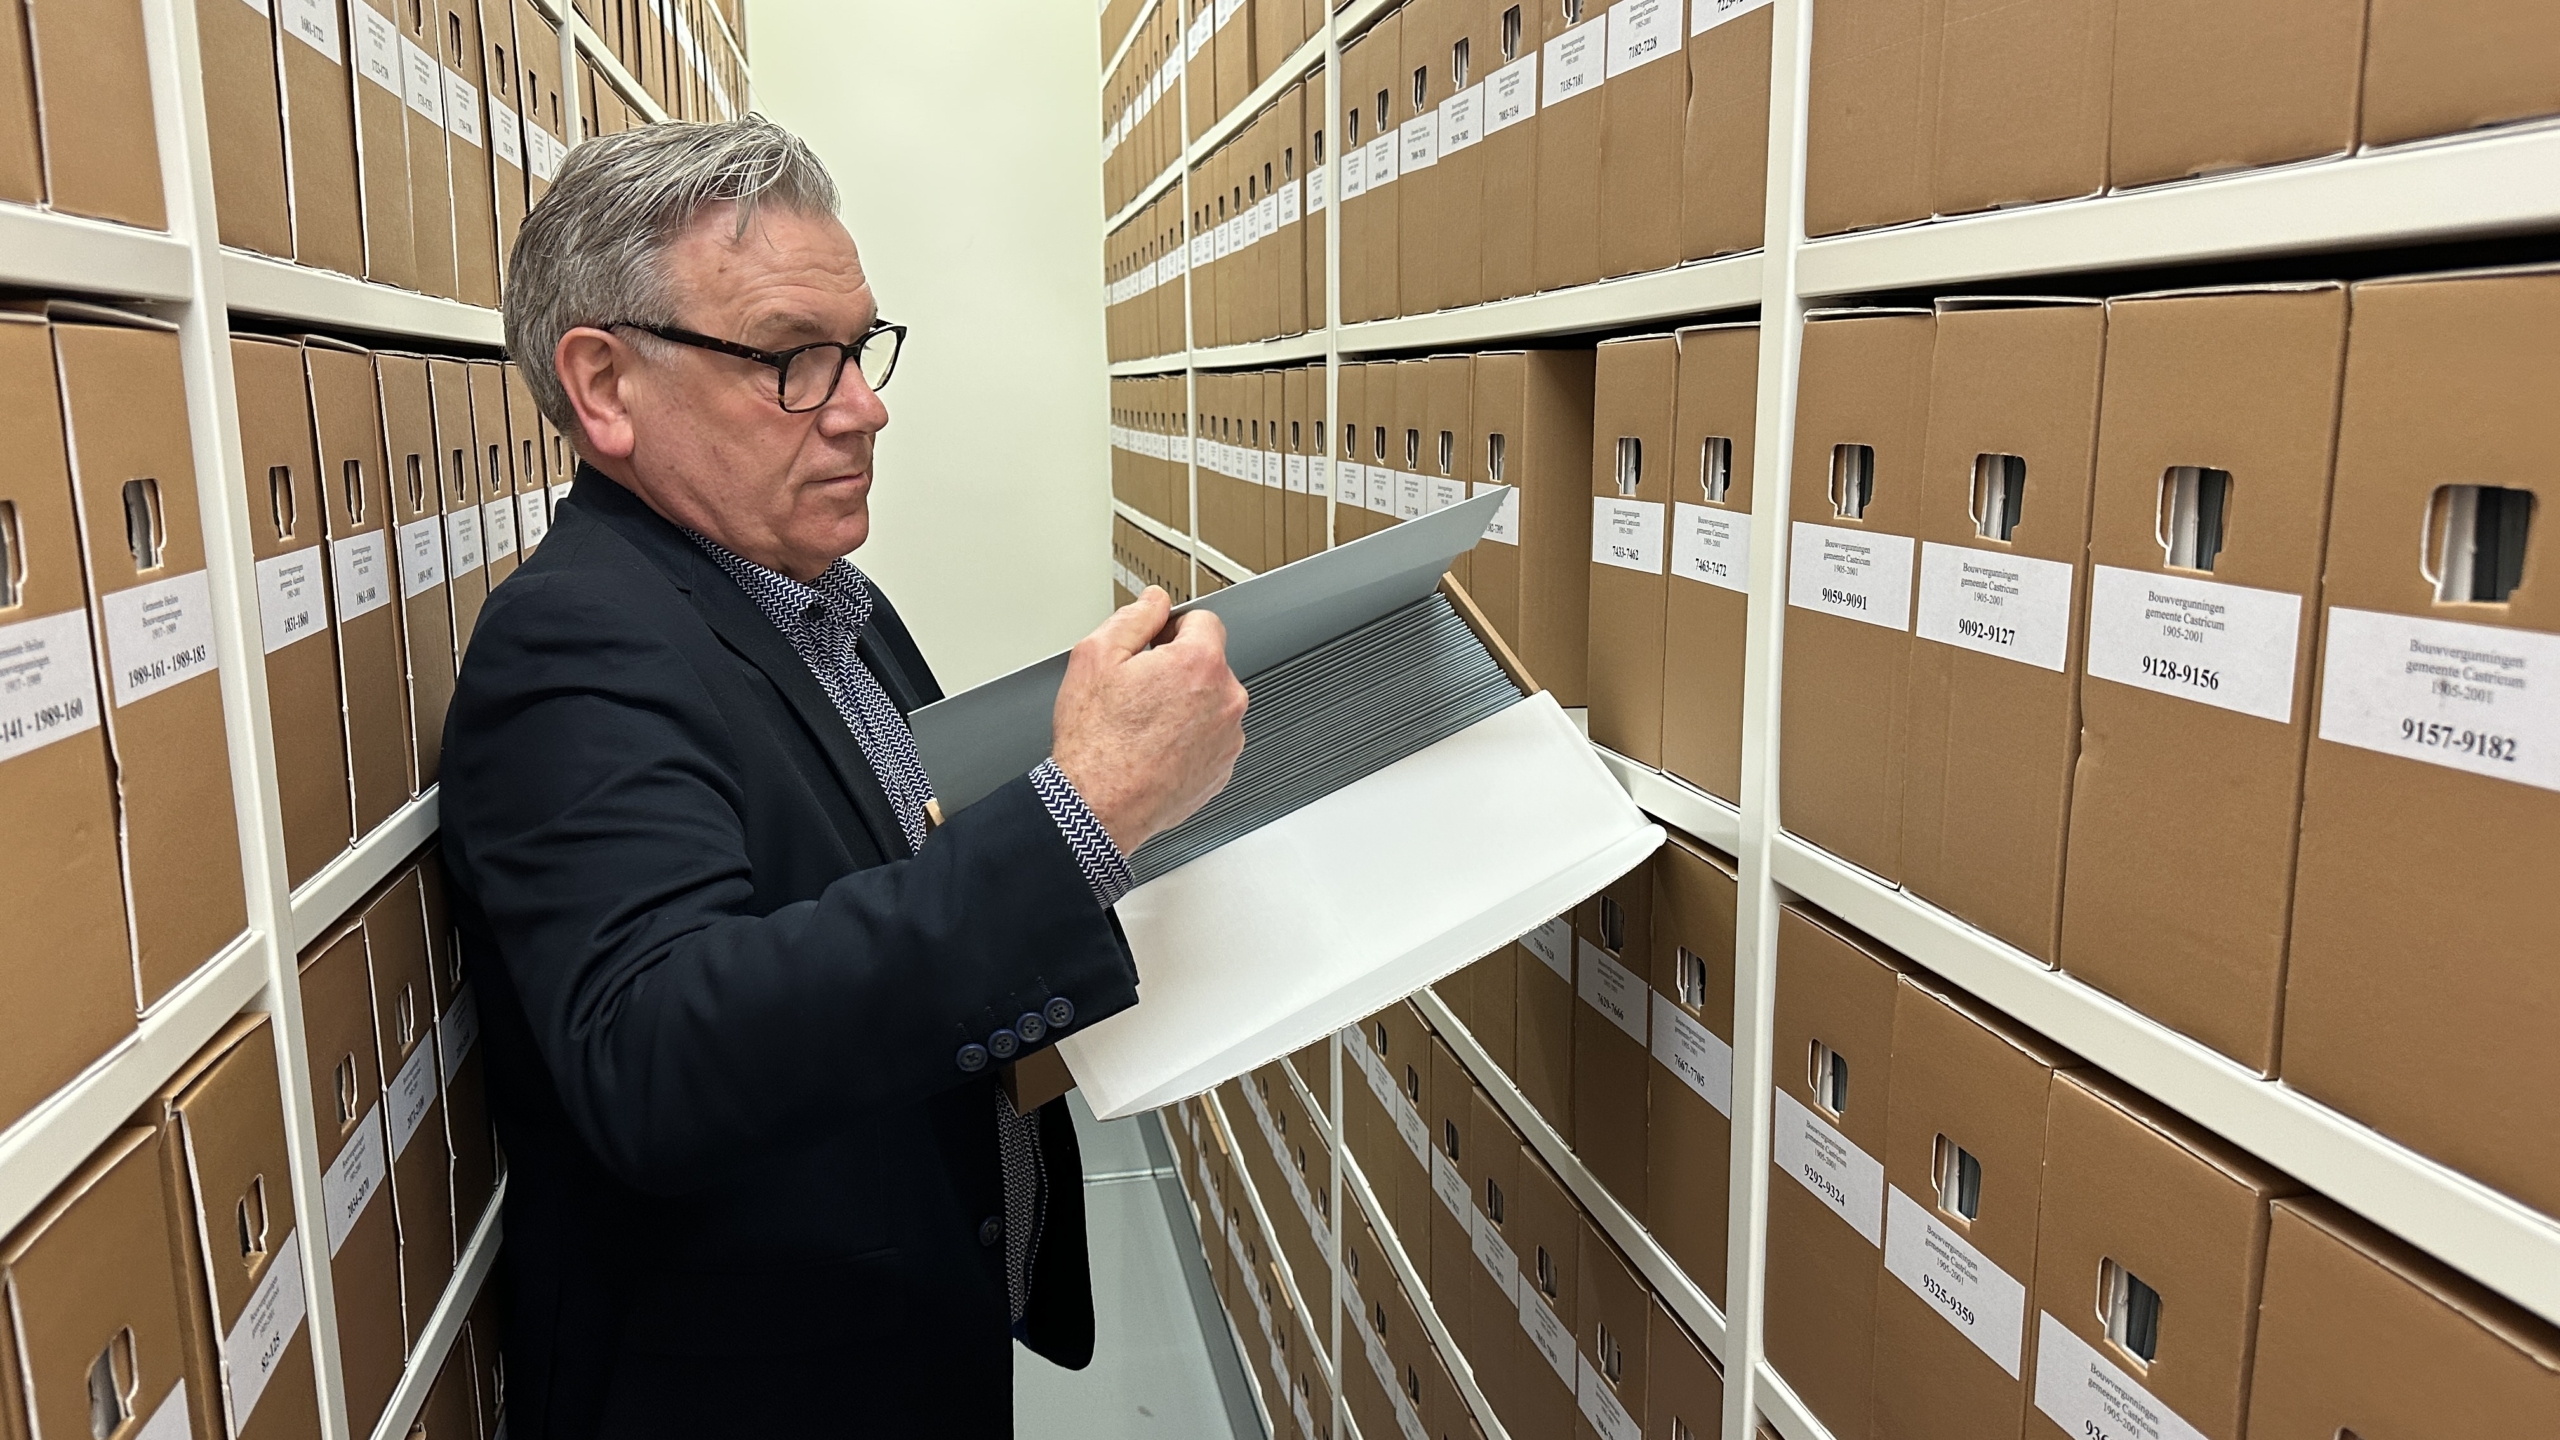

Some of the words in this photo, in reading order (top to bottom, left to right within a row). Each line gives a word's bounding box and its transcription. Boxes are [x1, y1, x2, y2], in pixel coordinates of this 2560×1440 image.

[1629, 36, 1657, 58] 7182-7228
[1612, 545, 1639, 561] 7433-7462
[1823, 553, 1845, 564] gemeente
[1846, 553, 1871, 566] Castricum
[1825, 539, 1871, 555] Bouwvergunningen
[1695, 558, 1727, 577] 7463-7472
[1834, 564, 1858, 576] 1905-2001
[1963, 562, 2019, 582] Bouwvergunningen
[1822, 587, 1867, 610] 9059-9091
[1960, 578, 1988, 591] gemeente
[1988, 580, 2019, 595] Castricum
[1974, 592, 2003, 606] 1905-2001
[2148, 590, 2225, 614] Bouwvergunningen
[284, 611, 309, 633] 1831-1860
[1959, 618, 2015, 646] 9092-9127
[2145, 608, 2182, 625] gemeente
[2184, 613, 2225, 631] Castricum
[2163, 625, 2203, 643] 1905-2001
[129, 660, 165, 688] 1989-161
[172, 644, 206, 671] 1989-183
[2410, 639, 2525, 669] Bouwvergunningen
[2143, 656, 2219, 690] 9128-9156
[2405, 661, 2459, 678] gemeente
[2462, 666, 2526, 688] Castricum
[2401, 718, 2516, 761] 9157-9182
[1674, 1053, 1705, 1087] 7667-7705
[1805, 1131, 1825, 1152] gemeente
[1824, 1145, 1847, 1168] Castricum
[1806, 1119, 1847, 1156] Bouwvergunningen
[1815, 1148, 1836, 1170] 1905-2001
[1804, 1164, 1845, 1207] 9292-9324
[1925, 1238, 1949, 1263] gemeente
[1950, 1256, 1978, 1284] Castricum
[1927, 1224, 1978, 1271] Bouwvergunningen
[1937, 1257, 1964, 1285] 1905-2001
[1923, 1274, 1975, 1325] 9325-9359
[2091, 1363, 2158, 1424] Bouwvergunningen
[2088, 1378, 2120, 1408] gemeente
[2122, 1404, 2158, 1440] Castricum
[2104, 1402, 2139, 1438] 1905-2001
